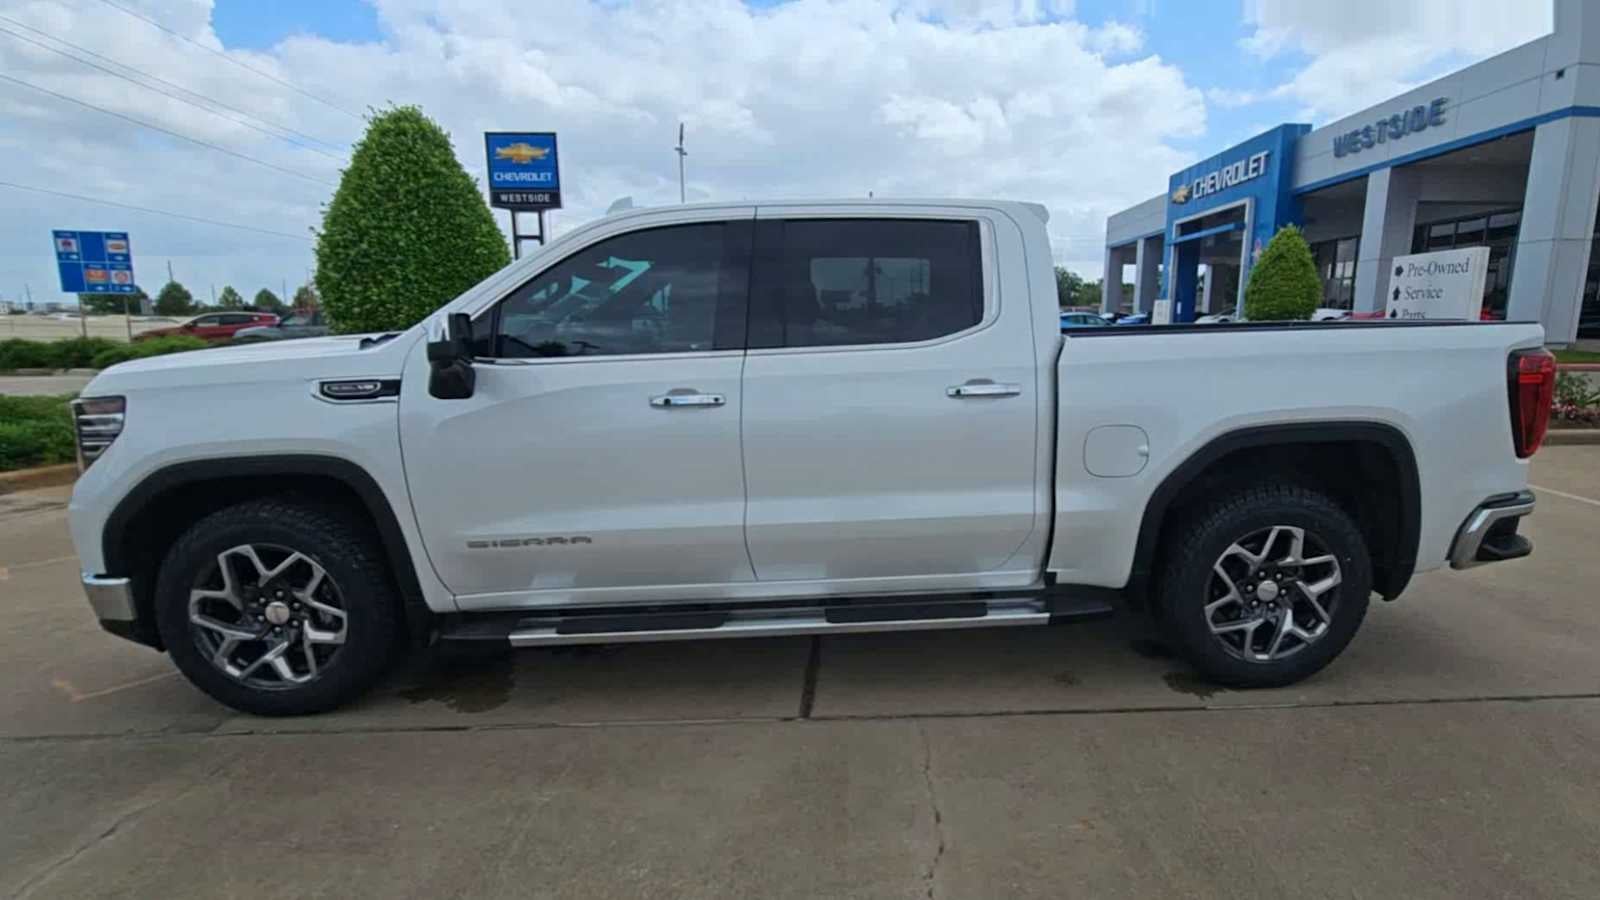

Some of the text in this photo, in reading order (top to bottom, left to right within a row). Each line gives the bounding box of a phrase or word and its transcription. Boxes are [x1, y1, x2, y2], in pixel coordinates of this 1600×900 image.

[1333, 97, 1448, 157] WESTSIDE
[493, 171, 553, 182] CHEVROLET
[1192, 150, 1270, 199] CHEVROLET
[500, 193, 551, 203] WESTSIDE
[1407, 257, 1471, 278] Pre-Owned
[1403, 283, 1444, 301] Service
[466, 535, 593, 549] SIERRA
